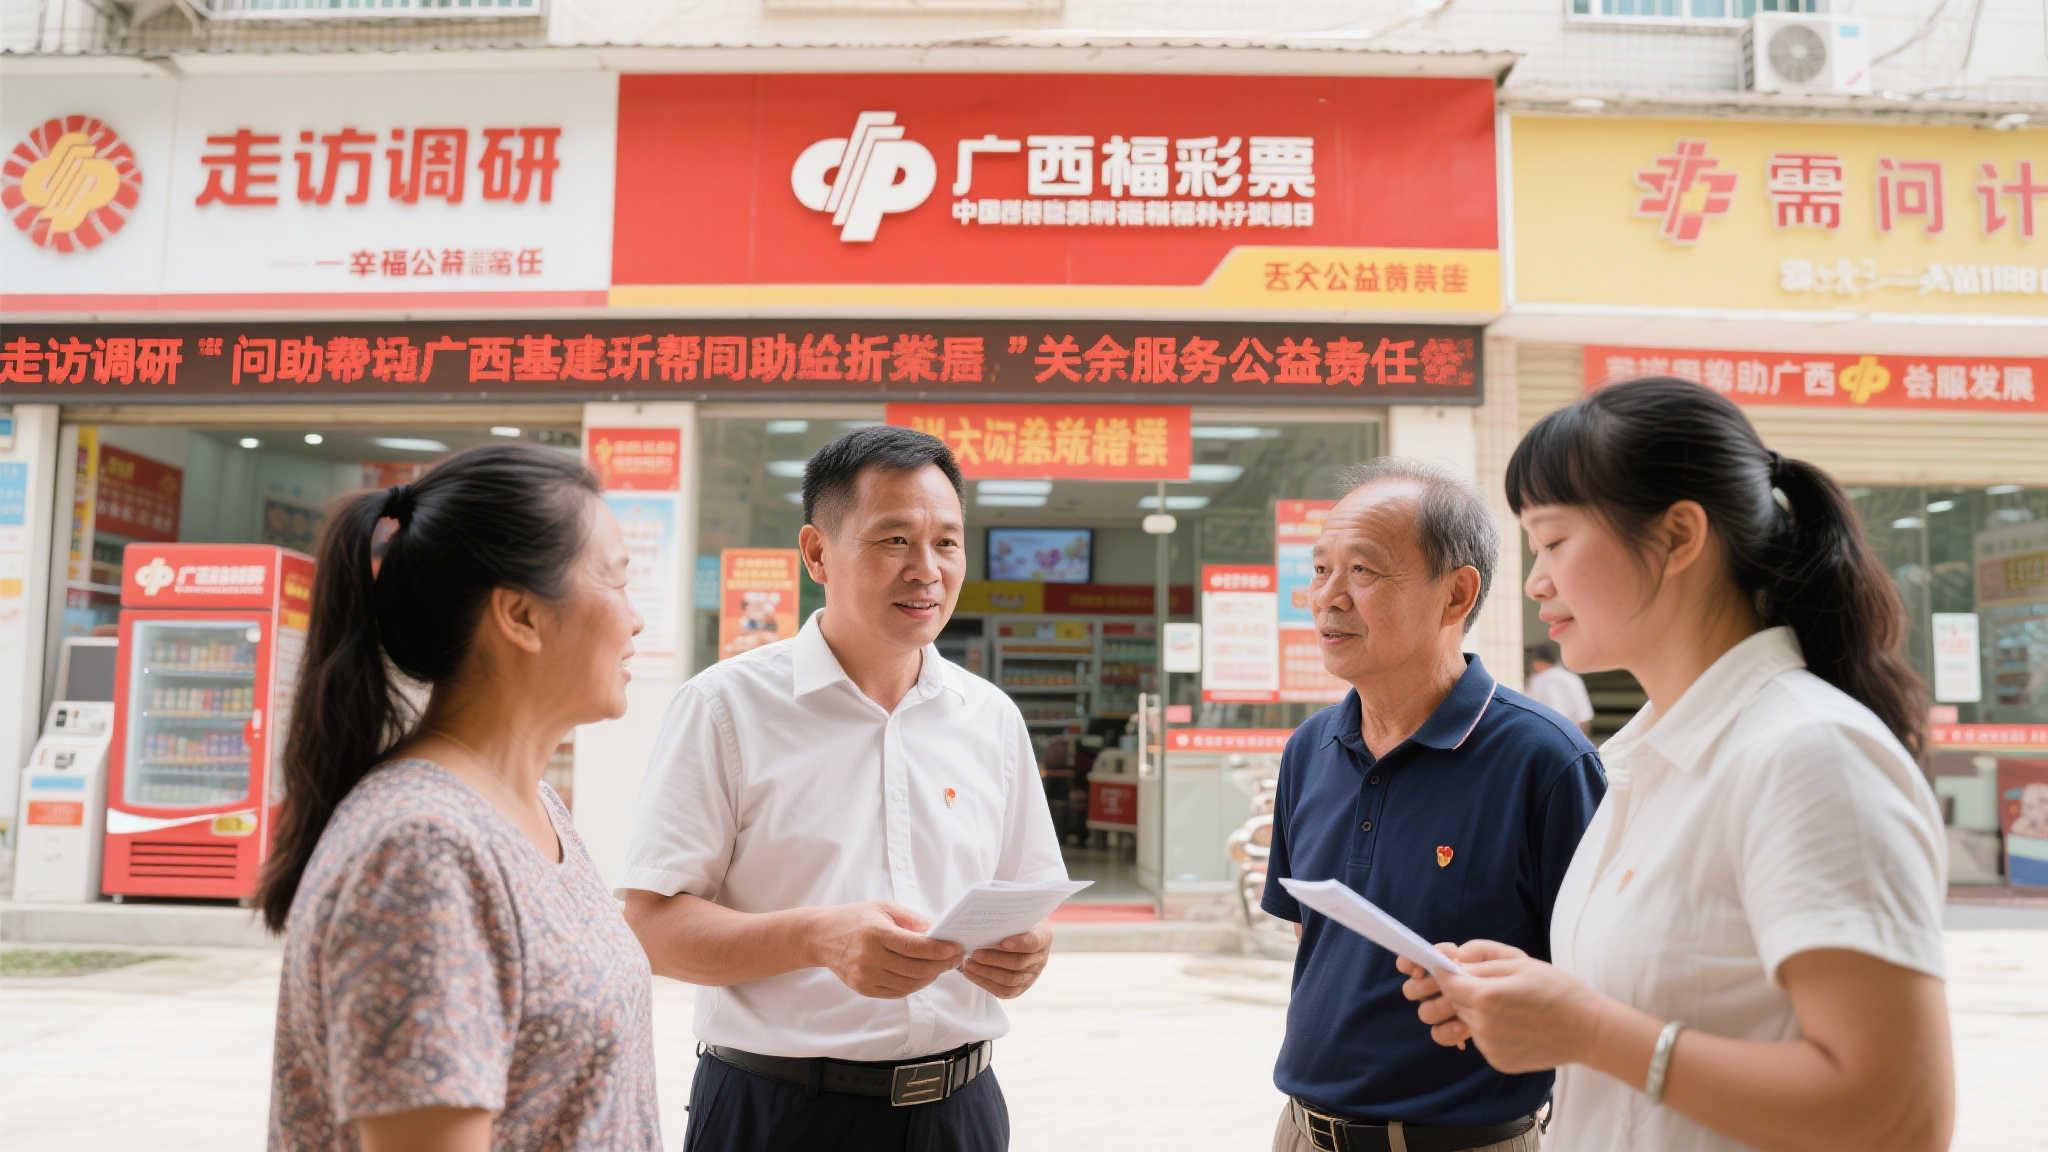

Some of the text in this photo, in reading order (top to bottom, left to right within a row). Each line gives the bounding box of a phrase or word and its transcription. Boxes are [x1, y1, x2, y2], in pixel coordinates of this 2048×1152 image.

[196, 128, 562, 206] 走访调研
[951, 134, 1316, 197] 广西福彩票
[1768, 151, 2048, 238] 需问计
